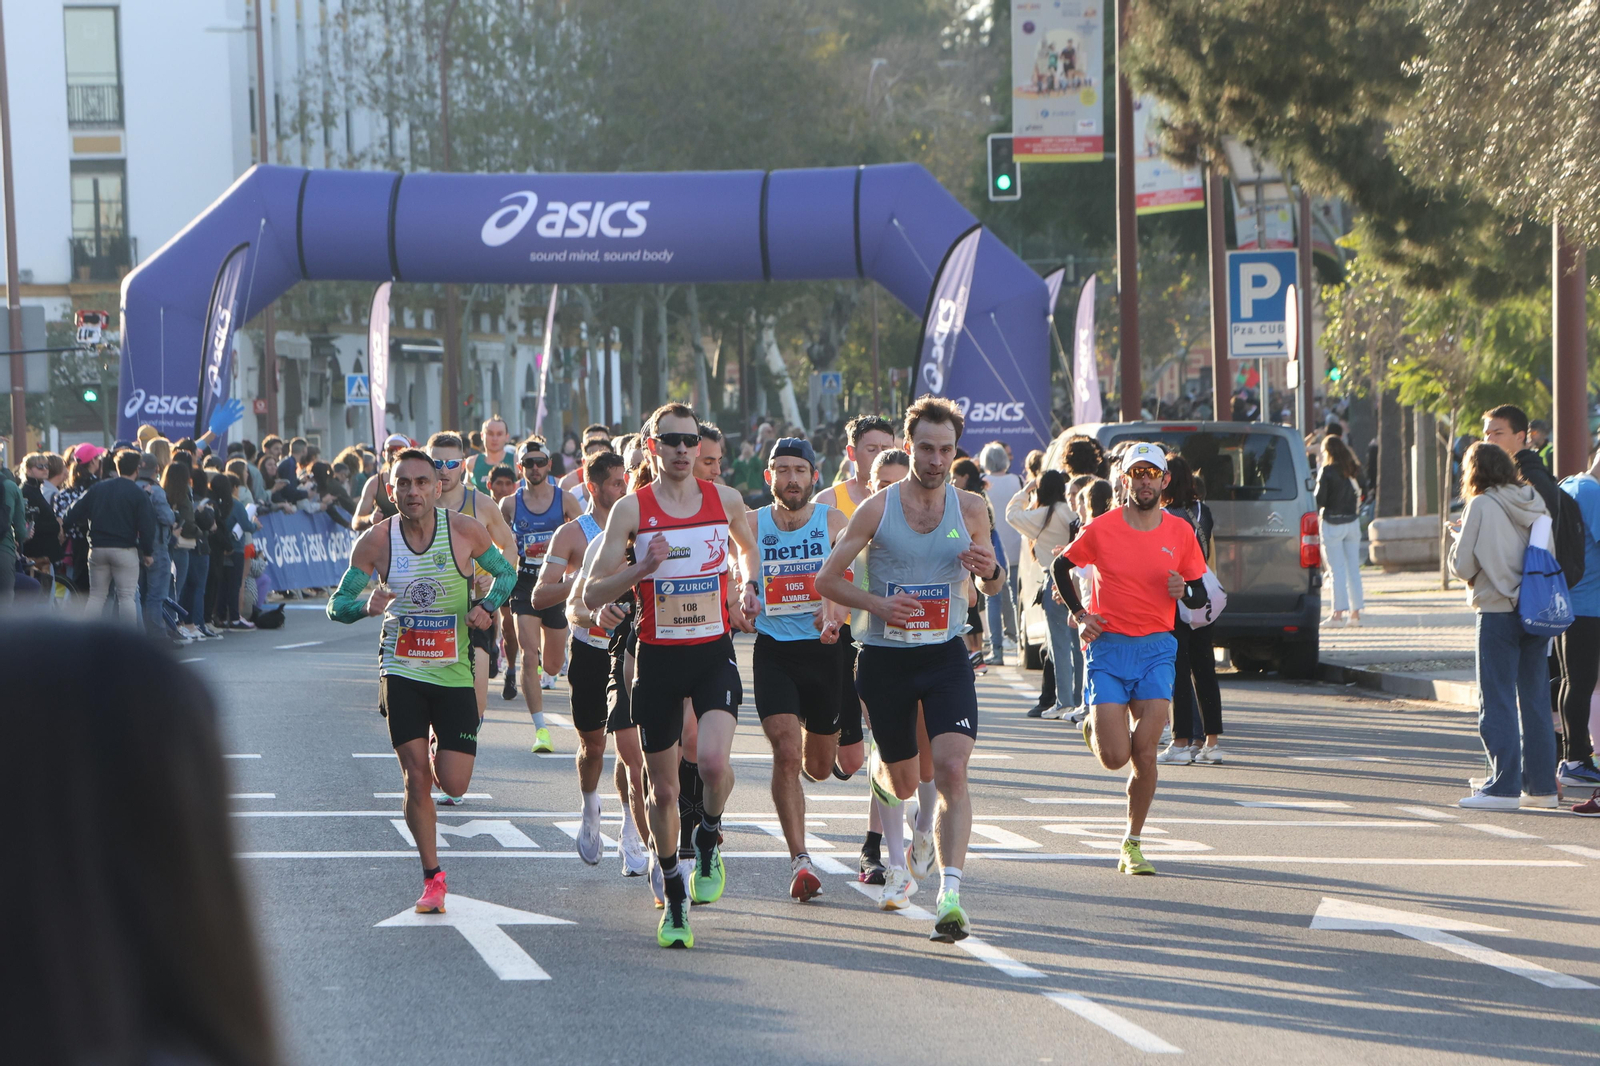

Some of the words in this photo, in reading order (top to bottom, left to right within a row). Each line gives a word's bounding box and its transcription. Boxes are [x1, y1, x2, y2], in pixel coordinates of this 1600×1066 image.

[529, 250, 567, 262] sound
[569, 250, 601, 262] mind,
[603, 250, 640, 262] sound
[642, 249, 674, 263] body
[1239, 262, 1281, 319] P
[1260, 324, 1285, 334] CUB
[764, 539, 823, 560] nerja
[784, 564, 816, 572] ZURICH
[678, 581, 713, 592] ZURICH
[785, 582, 804, 591] 1055
[782, 594, 810, 602] ALVAREZ
[682, 603, 697, 612] 108
[416, 619, 449, 628] ZURICH
[673, 614, 706, 624] SCHRÖER
[905, 621, 930, 629] VIKTOR
[416, 638, 435, 647] 1144
[408, 649, 444, 657] CARRASCO
